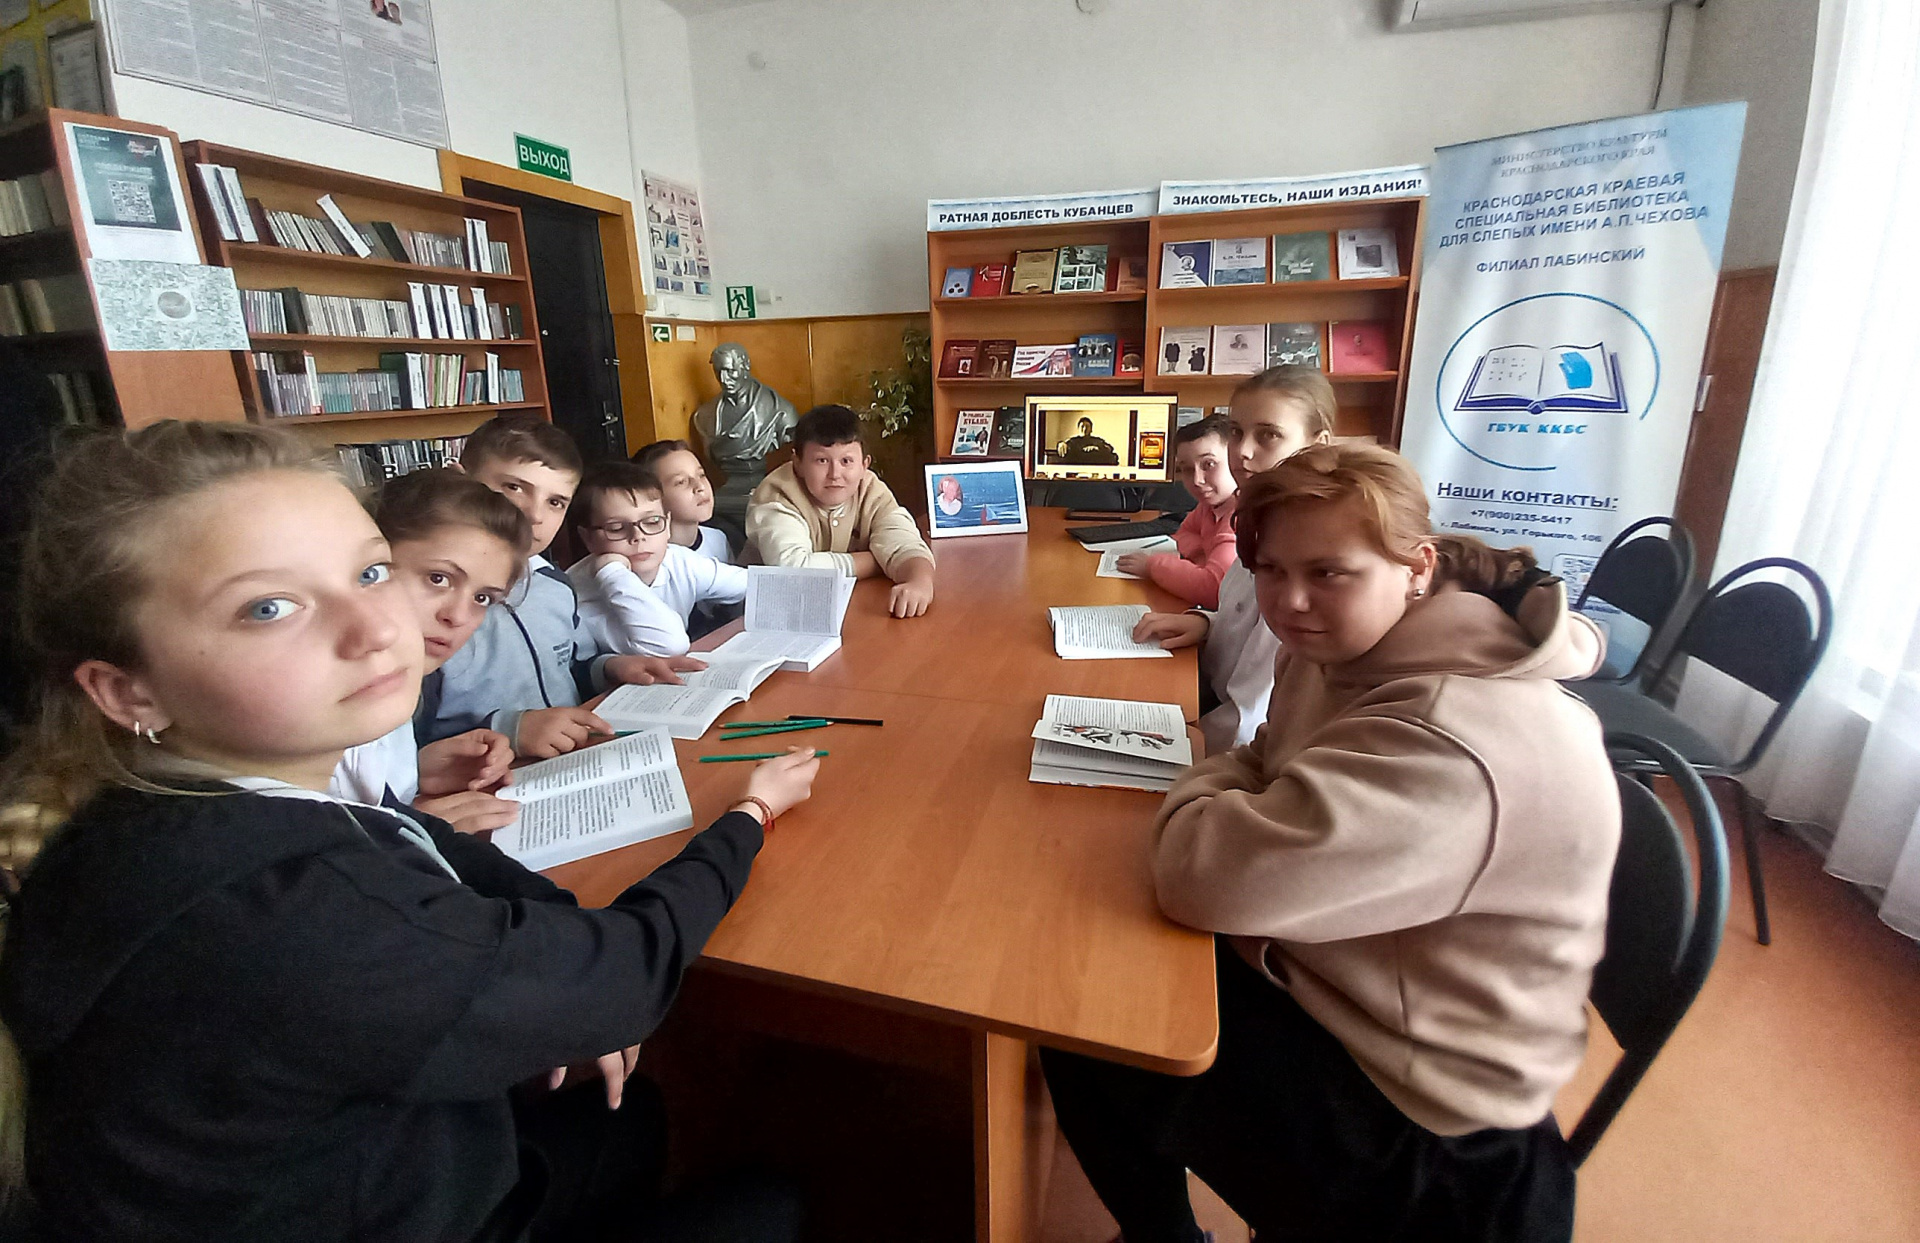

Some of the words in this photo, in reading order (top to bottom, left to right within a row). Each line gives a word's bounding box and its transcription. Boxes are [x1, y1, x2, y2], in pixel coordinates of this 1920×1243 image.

[519, 144, 570, 176] ВЫХОД
[1173, 193, 1283, 205] ЗНАКОМЬТЕСЬ,
[1286, 188, 1334, 202] НАШИ
[1338, 179, 1422, 196] ИЗДАНИЯ!
[1463, 184, 1598, 213] КРАСНОДАРСКАЯ
[1602, 171, 1686, 194] КРАЕВАЯ
[939, 212, 988, 223] РАТНАЯ
[991, 209, 1060, 223] ДОБЛЕСТЬ
[1063, 204, 1134, 218] КУБАНЦЕВ
[1455, 206, 1568, 230] СПЕЦИАЛЬНАЯ
[1572, 190, 1690, 216] БИБЛИОТЕКА
[1439, 233, 1468, 248] ДЛЯ
[1472, 225, 1536, 243] СЛЕПЫХ
[1540, 219, 1598, 237] ИМЕНИ
[1476, 256, 1540, 273] ФИЛИАЛ
[1543, 247, 1646, 268] ЛАБИНСКИЙ
[1487, 422, 1530, 434] ГБУК
[1537, 423, 1589, 435] ККБС
[1437, 482, 1495, 500] Наши
[1501, 489, 1619, 509] контакты:
[1470, 509, 1573, 525] +7(900)235-5417
